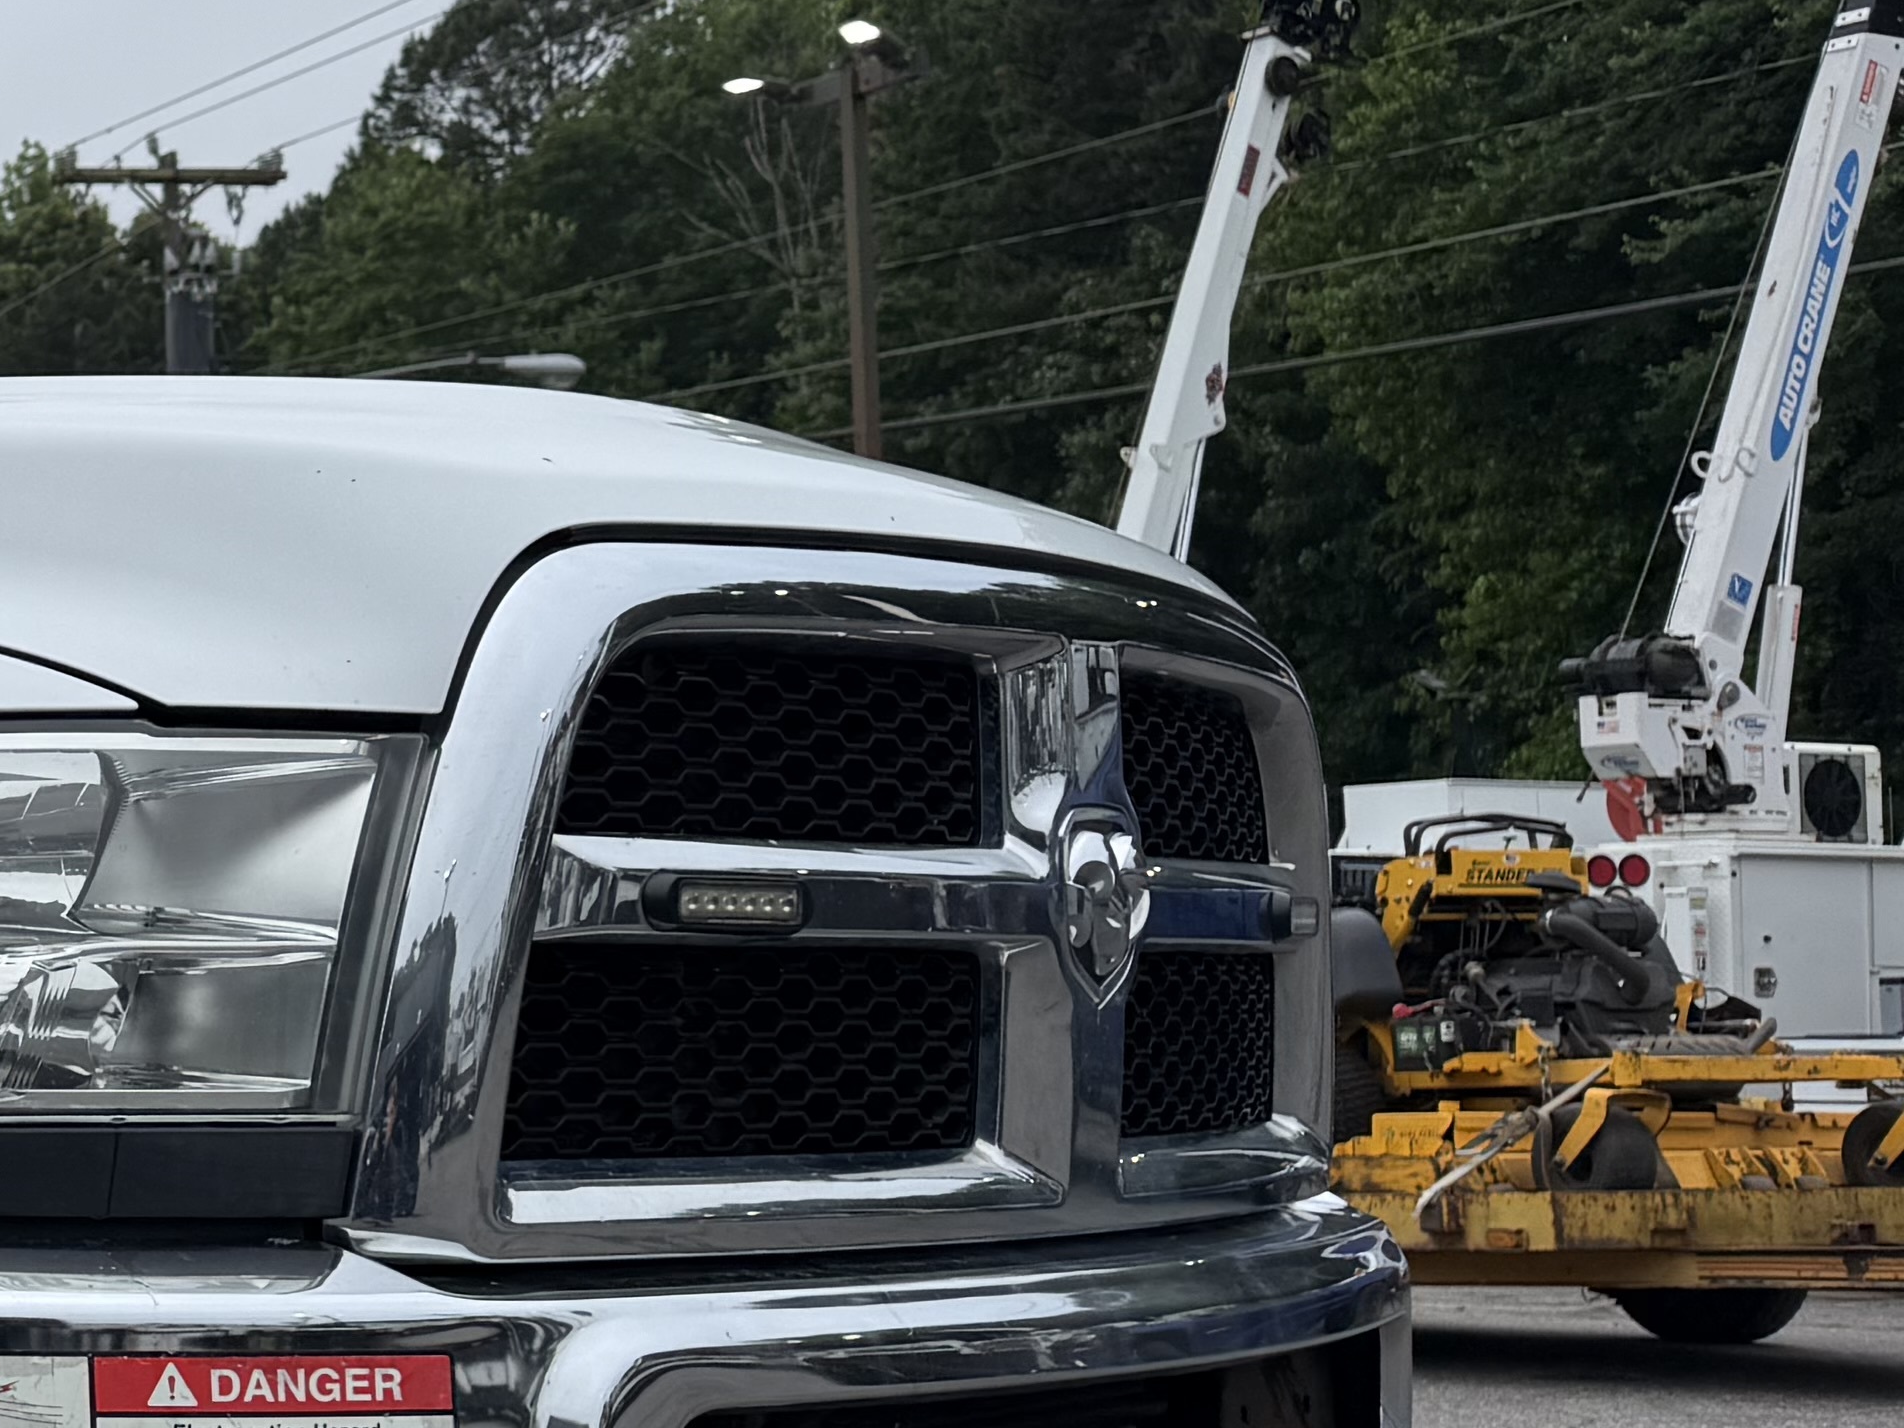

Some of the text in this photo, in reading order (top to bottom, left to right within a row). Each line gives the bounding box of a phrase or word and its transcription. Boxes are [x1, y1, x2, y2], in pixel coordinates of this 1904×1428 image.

[1778, 263, 1832, 432] AUTO CRANE
[210, 1367, 403, 1403] DANGER
